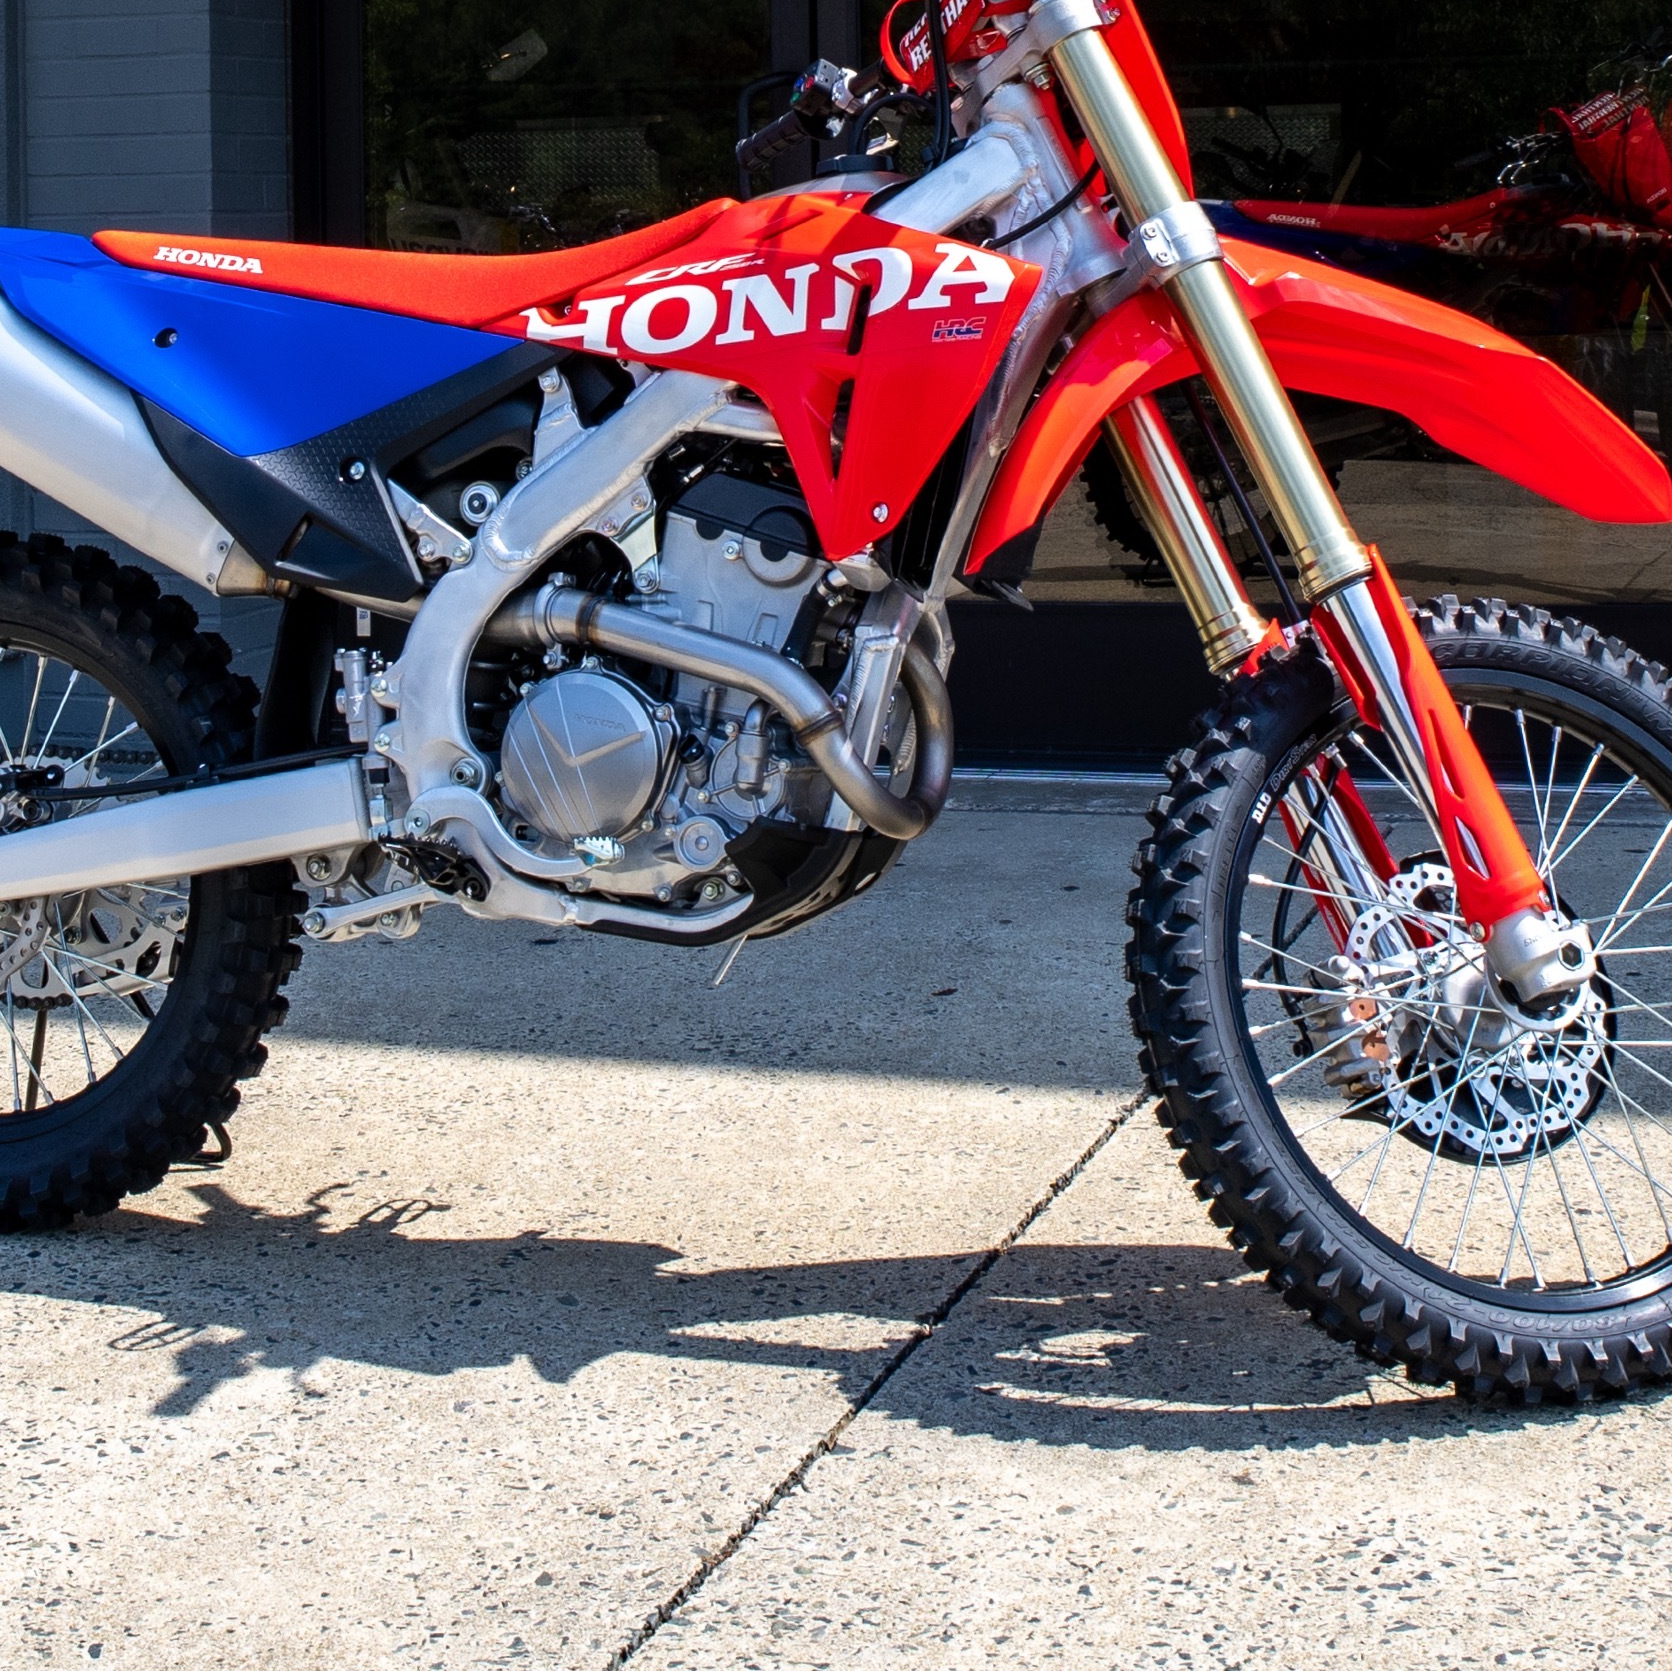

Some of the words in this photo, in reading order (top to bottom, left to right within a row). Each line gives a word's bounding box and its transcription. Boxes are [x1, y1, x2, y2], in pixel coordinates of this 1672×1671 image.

[153, 245, 264, 275] HONDA
[624, 252, 757, 286] CRF
[520, 242, 1015, 355] HONDA
[931, 316, 987, 337] HRC
[1428, 639, 1631, 703] CORPION
